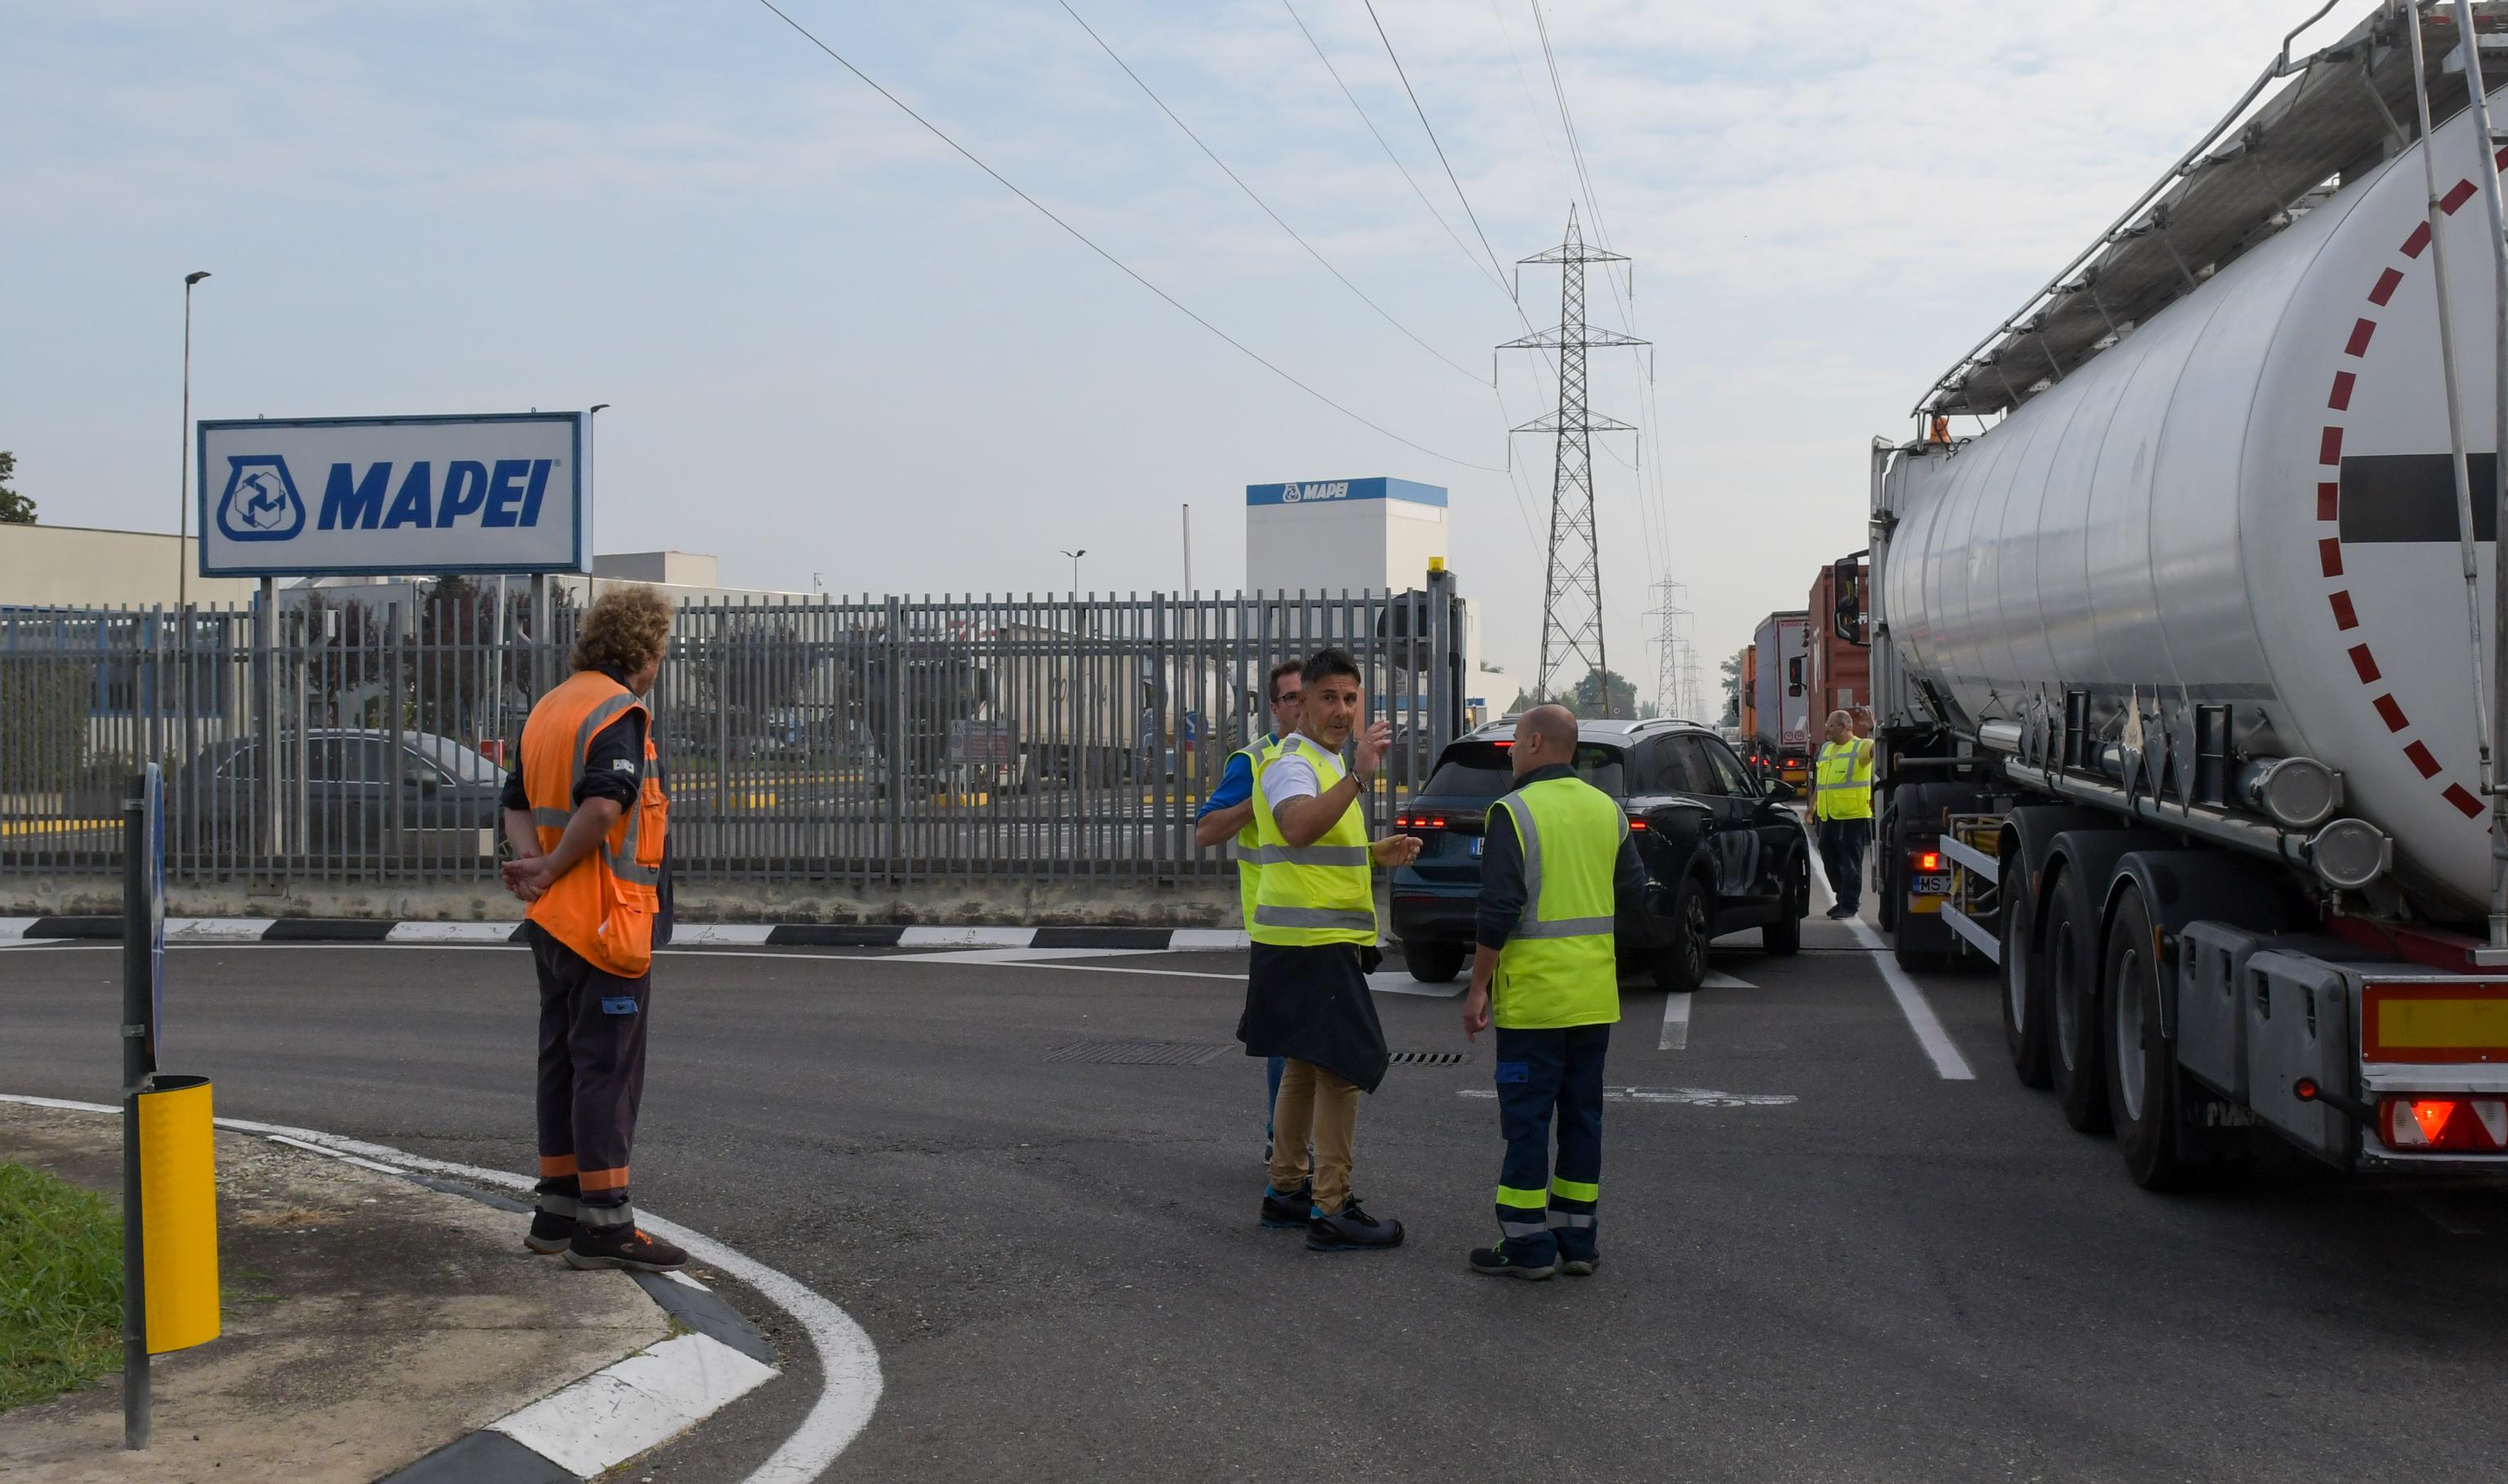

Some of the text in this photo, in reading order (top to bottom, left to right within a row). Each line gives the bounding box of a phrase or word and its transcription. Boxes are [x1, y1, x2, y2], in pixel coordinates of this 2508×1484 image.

[317, 459, 553, 531] MAPEI
[1303, 482, 1349, 500] MAPEI
[1920, 878, 1941, 891] MS
